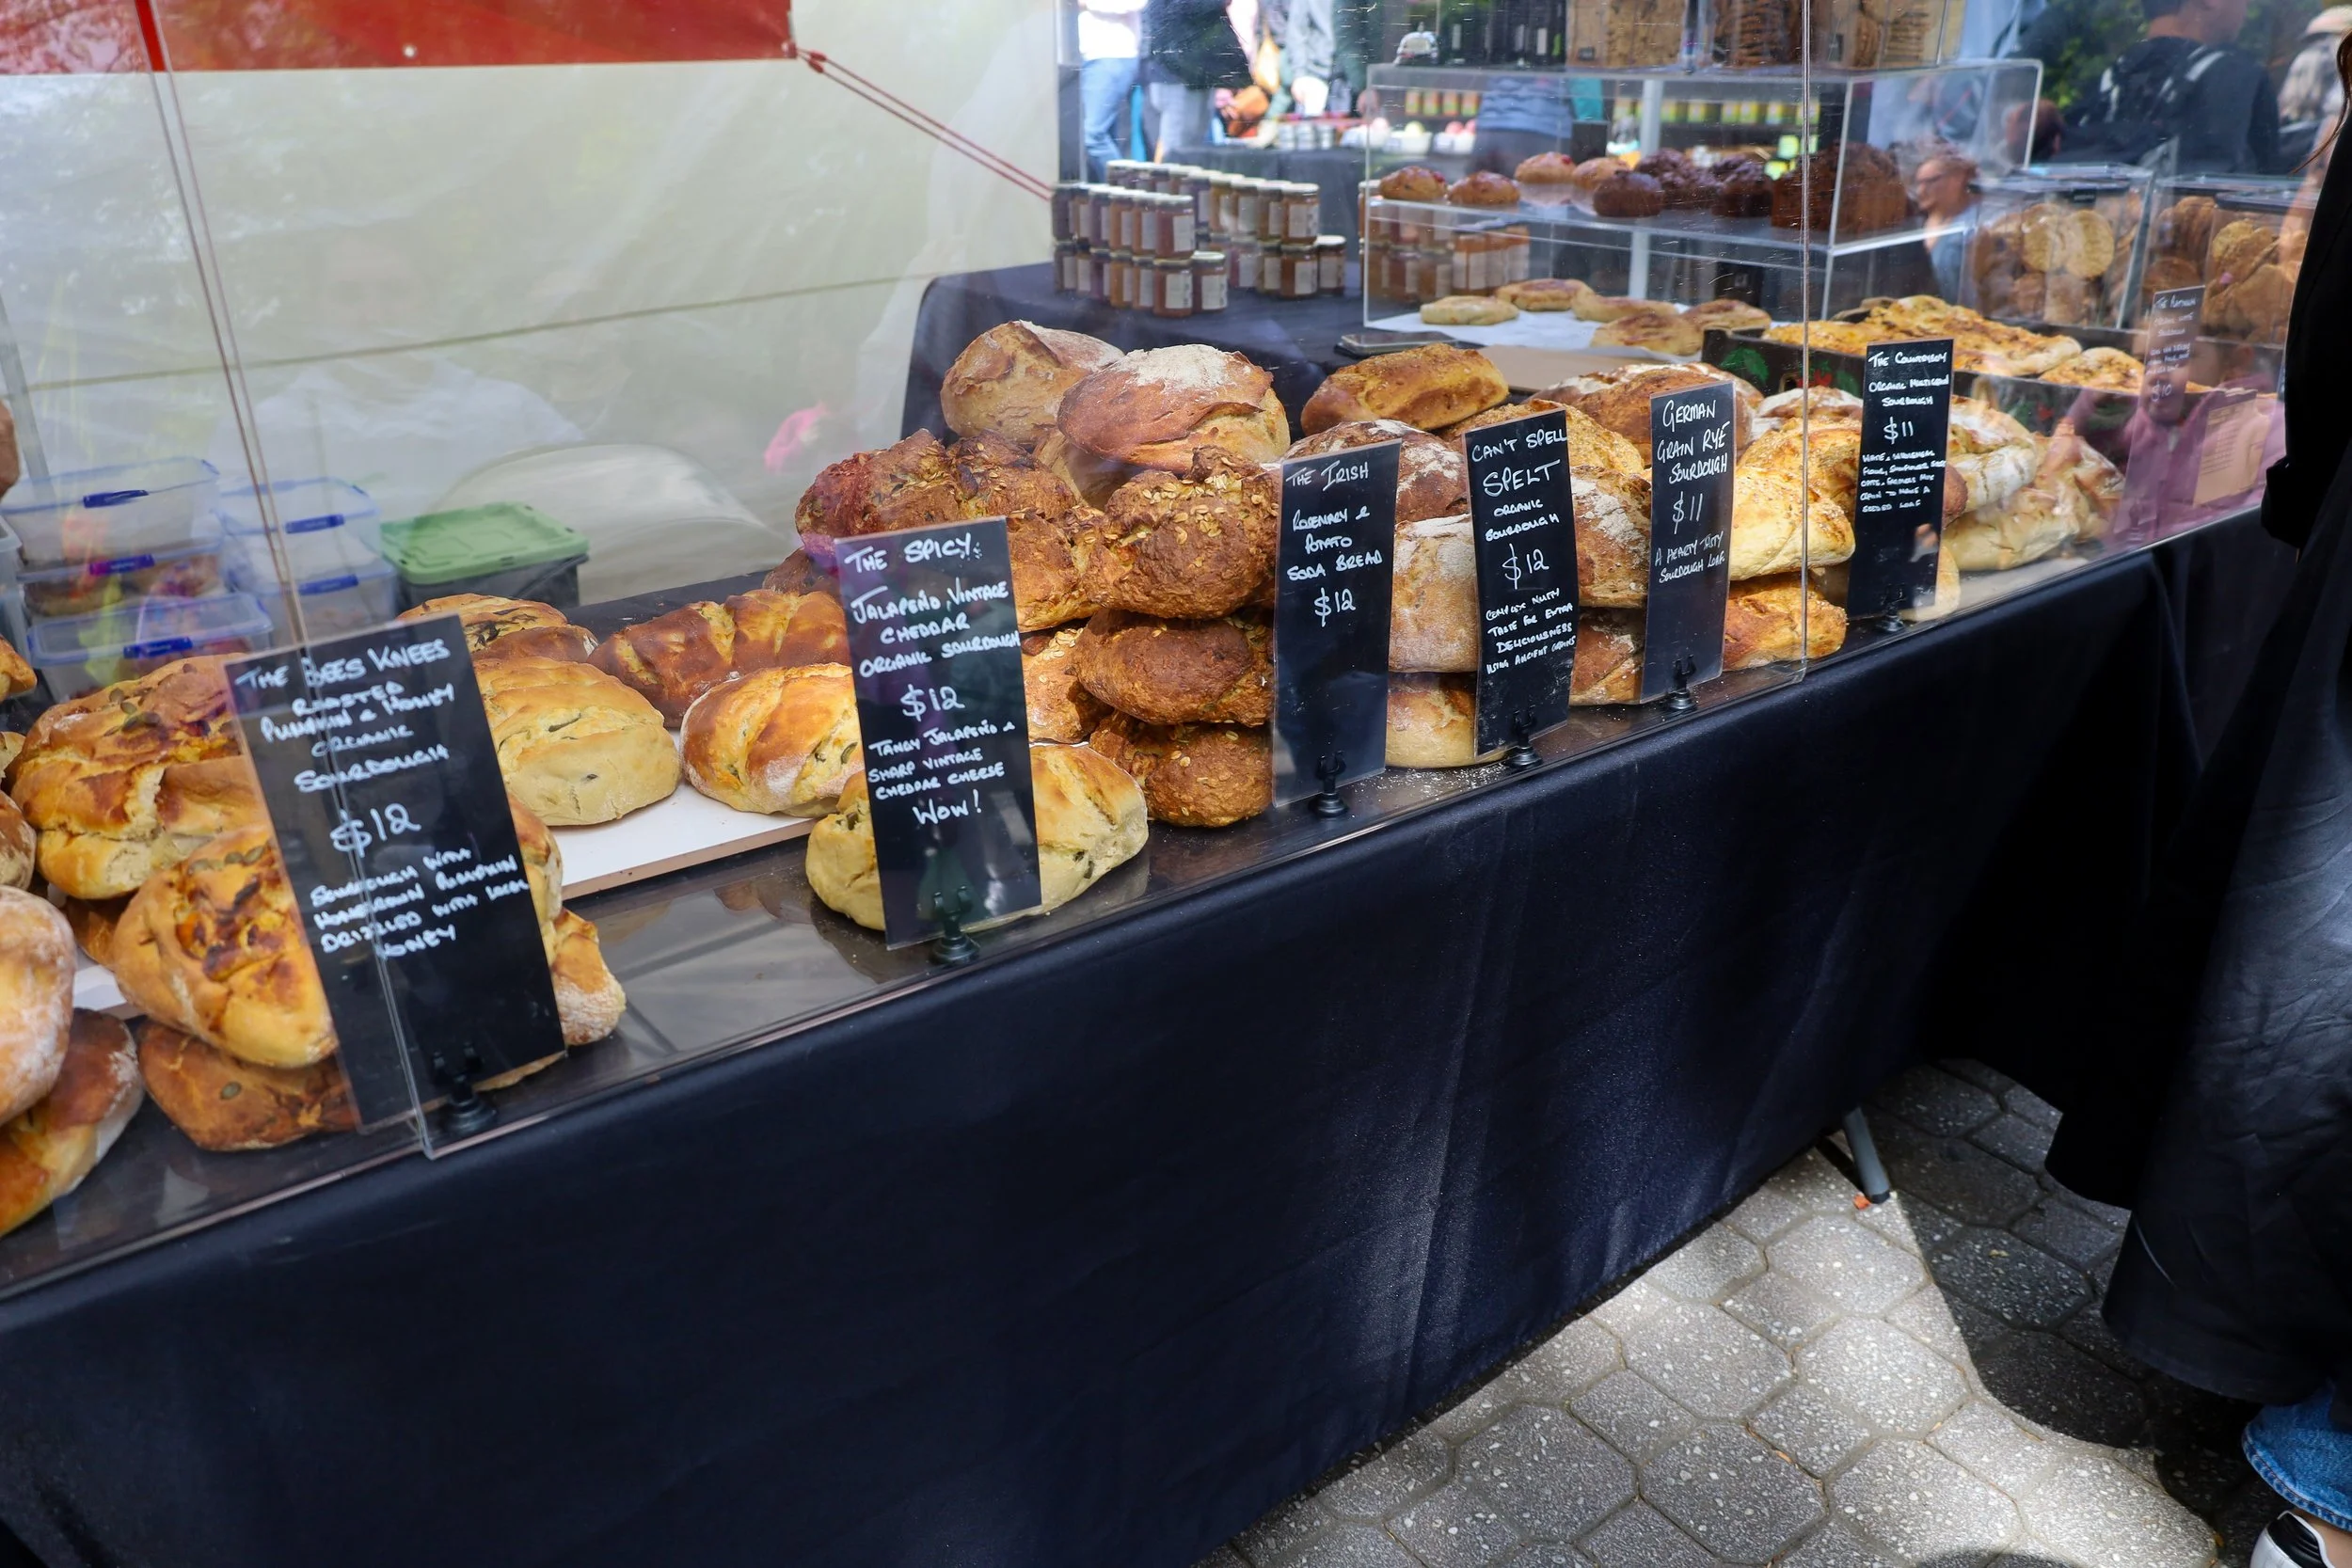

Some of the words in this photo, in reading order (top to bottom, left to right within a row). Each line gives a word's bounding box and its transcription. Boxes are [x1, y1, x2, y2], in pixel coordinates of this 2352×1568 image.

[1867, 351, 1890, 368] THE
[1868, 381, 1907, 393] ORGANIC
[1882, 395, 1934, 407] SOURDOUGH
[1662, 399, 1717, 433] GERMAN
[1883, 416, 1915, 445] $11
[1471, 438, 1518, 463] CAN'T
[1526, 428, 1568, 449] SPELL
[1657, 436, 1694, 464] GRAIN
[1702, 420, 1731, 452] RYE
[1285, 467, 1316, 487] THE
[1320, 460, 1369, 492] IRISH
[1483, 458, 1561, 497] SPELT
[1669, 452, 1727, 484] SOURDOUGH
[1899, 499, 1921, 508] LOAF
[1923, 485, 1931, 494] A
[1355, 505, 1371, 521] &
[1493, 499, 1544, 517] ORGANIC
[1672, 491, 1703, 535] $11
[1305, 532, 1353, 555] POTATO
[1485, 513, 1560, 542] SOURDOUGH
[845, 546, 887, 573] THE
[1286, 562, 1327, 581] SODA
[1335, 548, 1383, 572] BREAD
[1654, 547, 1662, 566] A
[1666, 539, 1698, 564] HEARTY
[1699, 531, 1724, 551] TASTY
[1502, 543, 1549, 590] $12
[1659, 559, 1704, 584] SOURDOUGH
[946, 577, 1009, 606] VINTAGE
[1314, 587, 1357, 628] $12
[1532, 587, 1560, 604] NUTTY
[881, 612, 971, 645] CHEDDAR
[1487, 620, 1518, 637] TASTE
[1523, 614, 1538, 626] FOR
[1545, 602, 1573, 620] EXTRA
[859, 651, 932, 677] ORGANIC
[941, 630, 1021, 658] SOURDOUGH
[1496, 622, 1573, 654] DELICIOUSNESS
[234, 666, 289, 689] THE
[367, 638, 451, 672] KNEES
[1486, 659, 1509, 674] USING
[1515, 645, 1549, 666] ANCIENT
[382, 683, 455, 715] HONEY
[900, 684, 965, 721] $12
[868, 738, 921, 757] TANGY
[294, 743, 450, 793] SOURDOUGH
[867, 761, 915, 784] SHARP
[923, 747, 984, 770] VINTAGE
[875, 776, 941, 800] CHEDDAR
[947, 761, 1005, 785] CHEESE
[330, 802, 422, 858] $12
[423, 847, 471, 871] WITH
[432, 894, 479, 917] WITH
